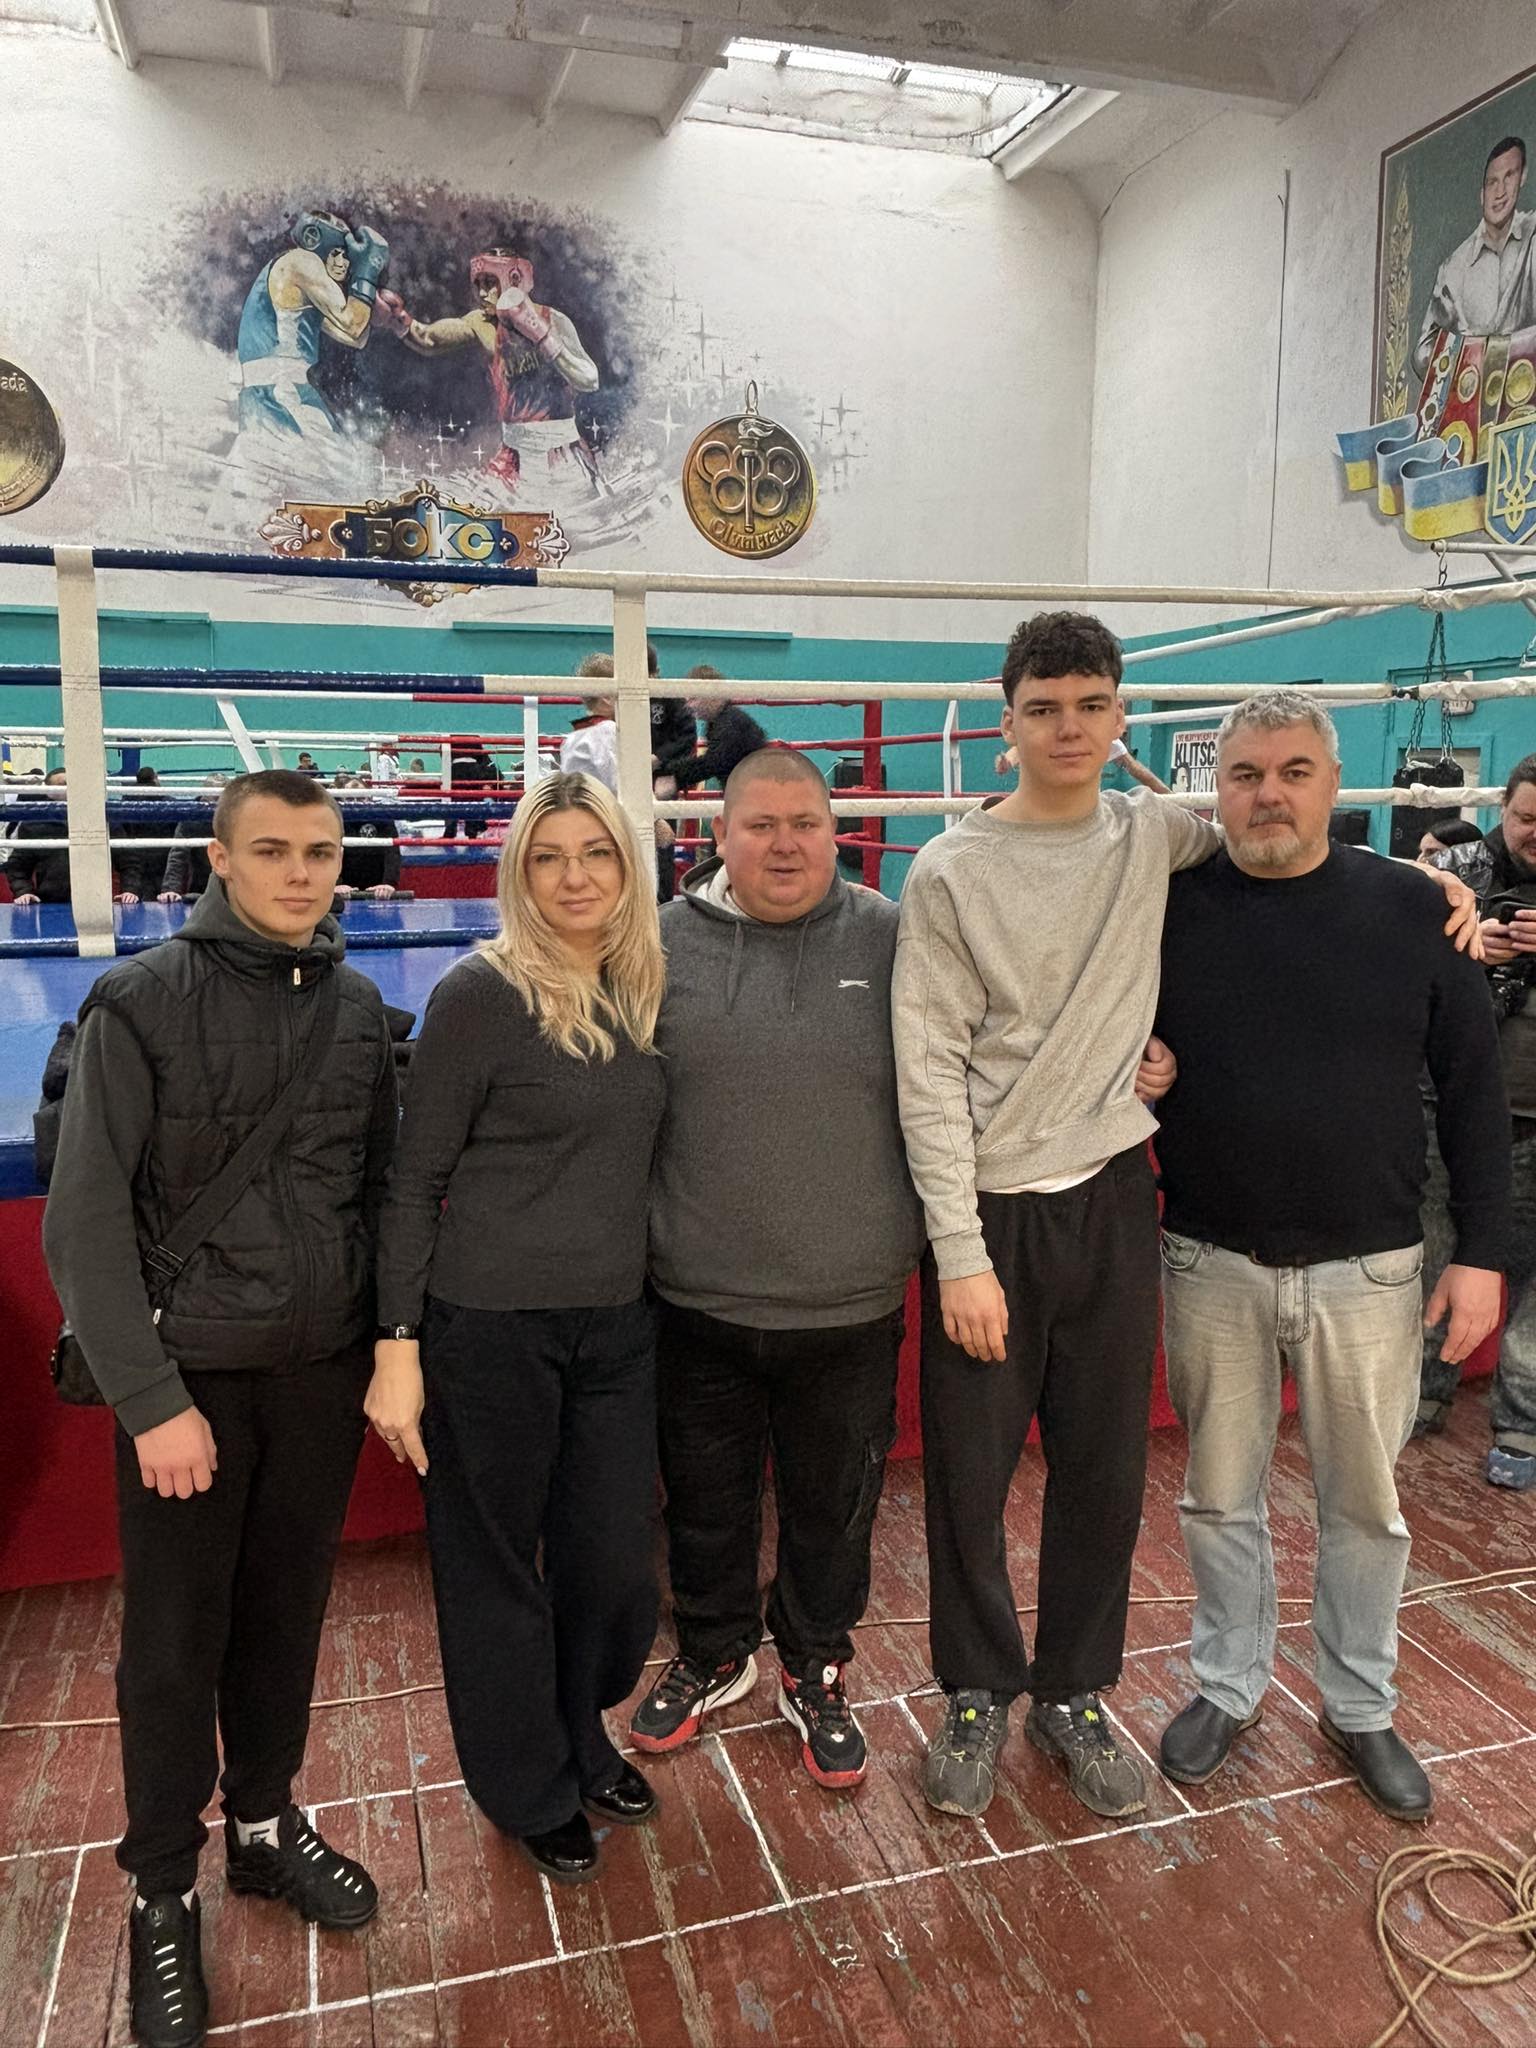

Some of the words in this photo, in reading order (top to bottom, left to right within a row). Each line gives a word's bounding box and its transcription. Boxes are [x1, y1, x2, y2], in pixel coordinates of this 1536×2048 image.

[365, 510, 495, 560] БОКС
[1175, 741, 1217, 767] KLITSC
[1191, 768, 1217, 792] HAY
